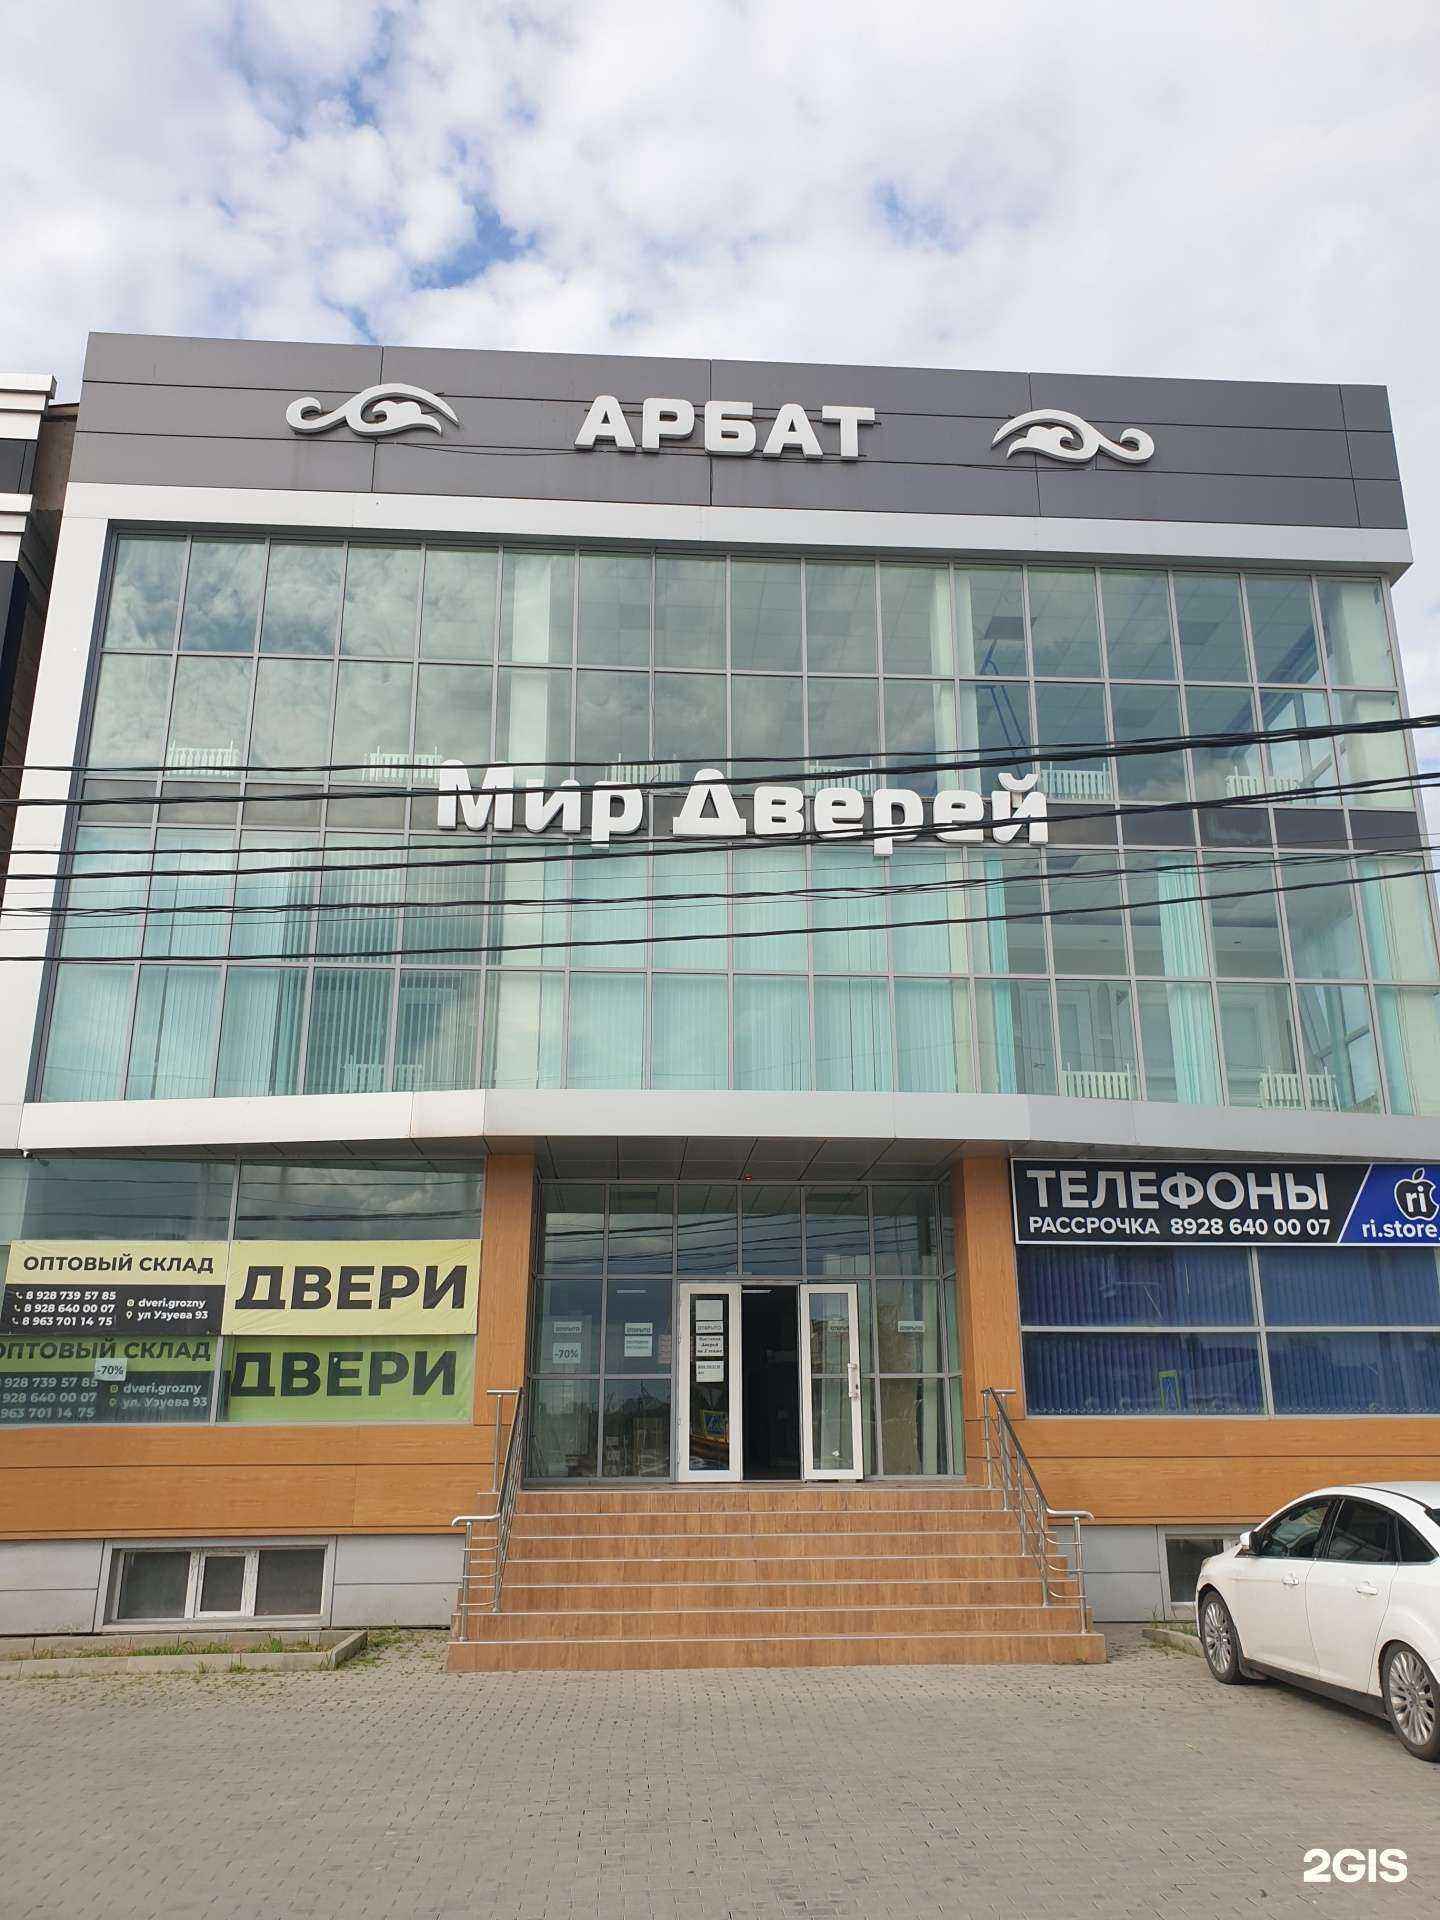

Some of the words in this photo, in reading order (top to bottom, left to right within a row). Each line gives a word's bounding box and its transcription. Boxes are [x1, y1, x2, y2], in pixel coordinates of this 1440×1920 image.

[574, 395, 876, 459] АРБАТ
[437, 760, 644, 848] Мир
[672, 769, 1049, 857] Дверей
[1026, 1169, 1330, 1211] ТЕЛЕФОНЫ
[1405, 1185, 1427, 1213] ri
[1029, 1215, 1161, 1235] РАССРОЧКА
[1170, 1217, 1224, 1236] 8928
[1229, 1218, 1268, 1236] 640
[1273, 1218, 1301, 1237] 00
[1306, 1218, 1332, 1237] 07
[1361, 1218, 1440, 1241] ri.store
[23, 1251, 136, 1272] ОПТОВЫЙ
[139, 1256, 215, 1275] СКЛАД
[235, 1264, 468, 1310] ДВЕРИ
[26, 1291, 34, 1300] 8
[36, 1291, 57, 1301] 928
[59, 1291, 81, 1301] 739
[84, 1291, 98, 1301] 57
[101, 1291, 117, 1301] 85
[138, 1297, 206, 1309] dveri.grozny
[24, 1304, 32, 1313] 8
[34, 1304, 56, 1314] 928
[58, 1304, 80, 1313] 640
[82, 1304, 98, 1313] 00
[100, 1304, 115, 1313] 07
[137, 1310, 151, 1321] ул
[153, 1310, 192, 1321] Узуева
[195, 1310, 208, 1320] 93
[22, 1316, 30, 1326] 8
[32, 1316, 54, 1326] 963
[56, 1316, 76, 1326] 701
[80, 1316, 95, 1326] 14
[98, 1316, 113, 1326] 75
[123, 1342, 211, 1362] СКЛАД
[554, 1349, 579, 1359] -70%
[97, 1365, 124, 1376] -70%
[230, 1350, 458, 1397] ДВЕРИ
[32, 1377, 57, 1388] 739
[60, 1377, 79, 1388] 57
[123, 1382, 201, 1395] dveri.grozny
[192, 1396, 208, 1407] 93
